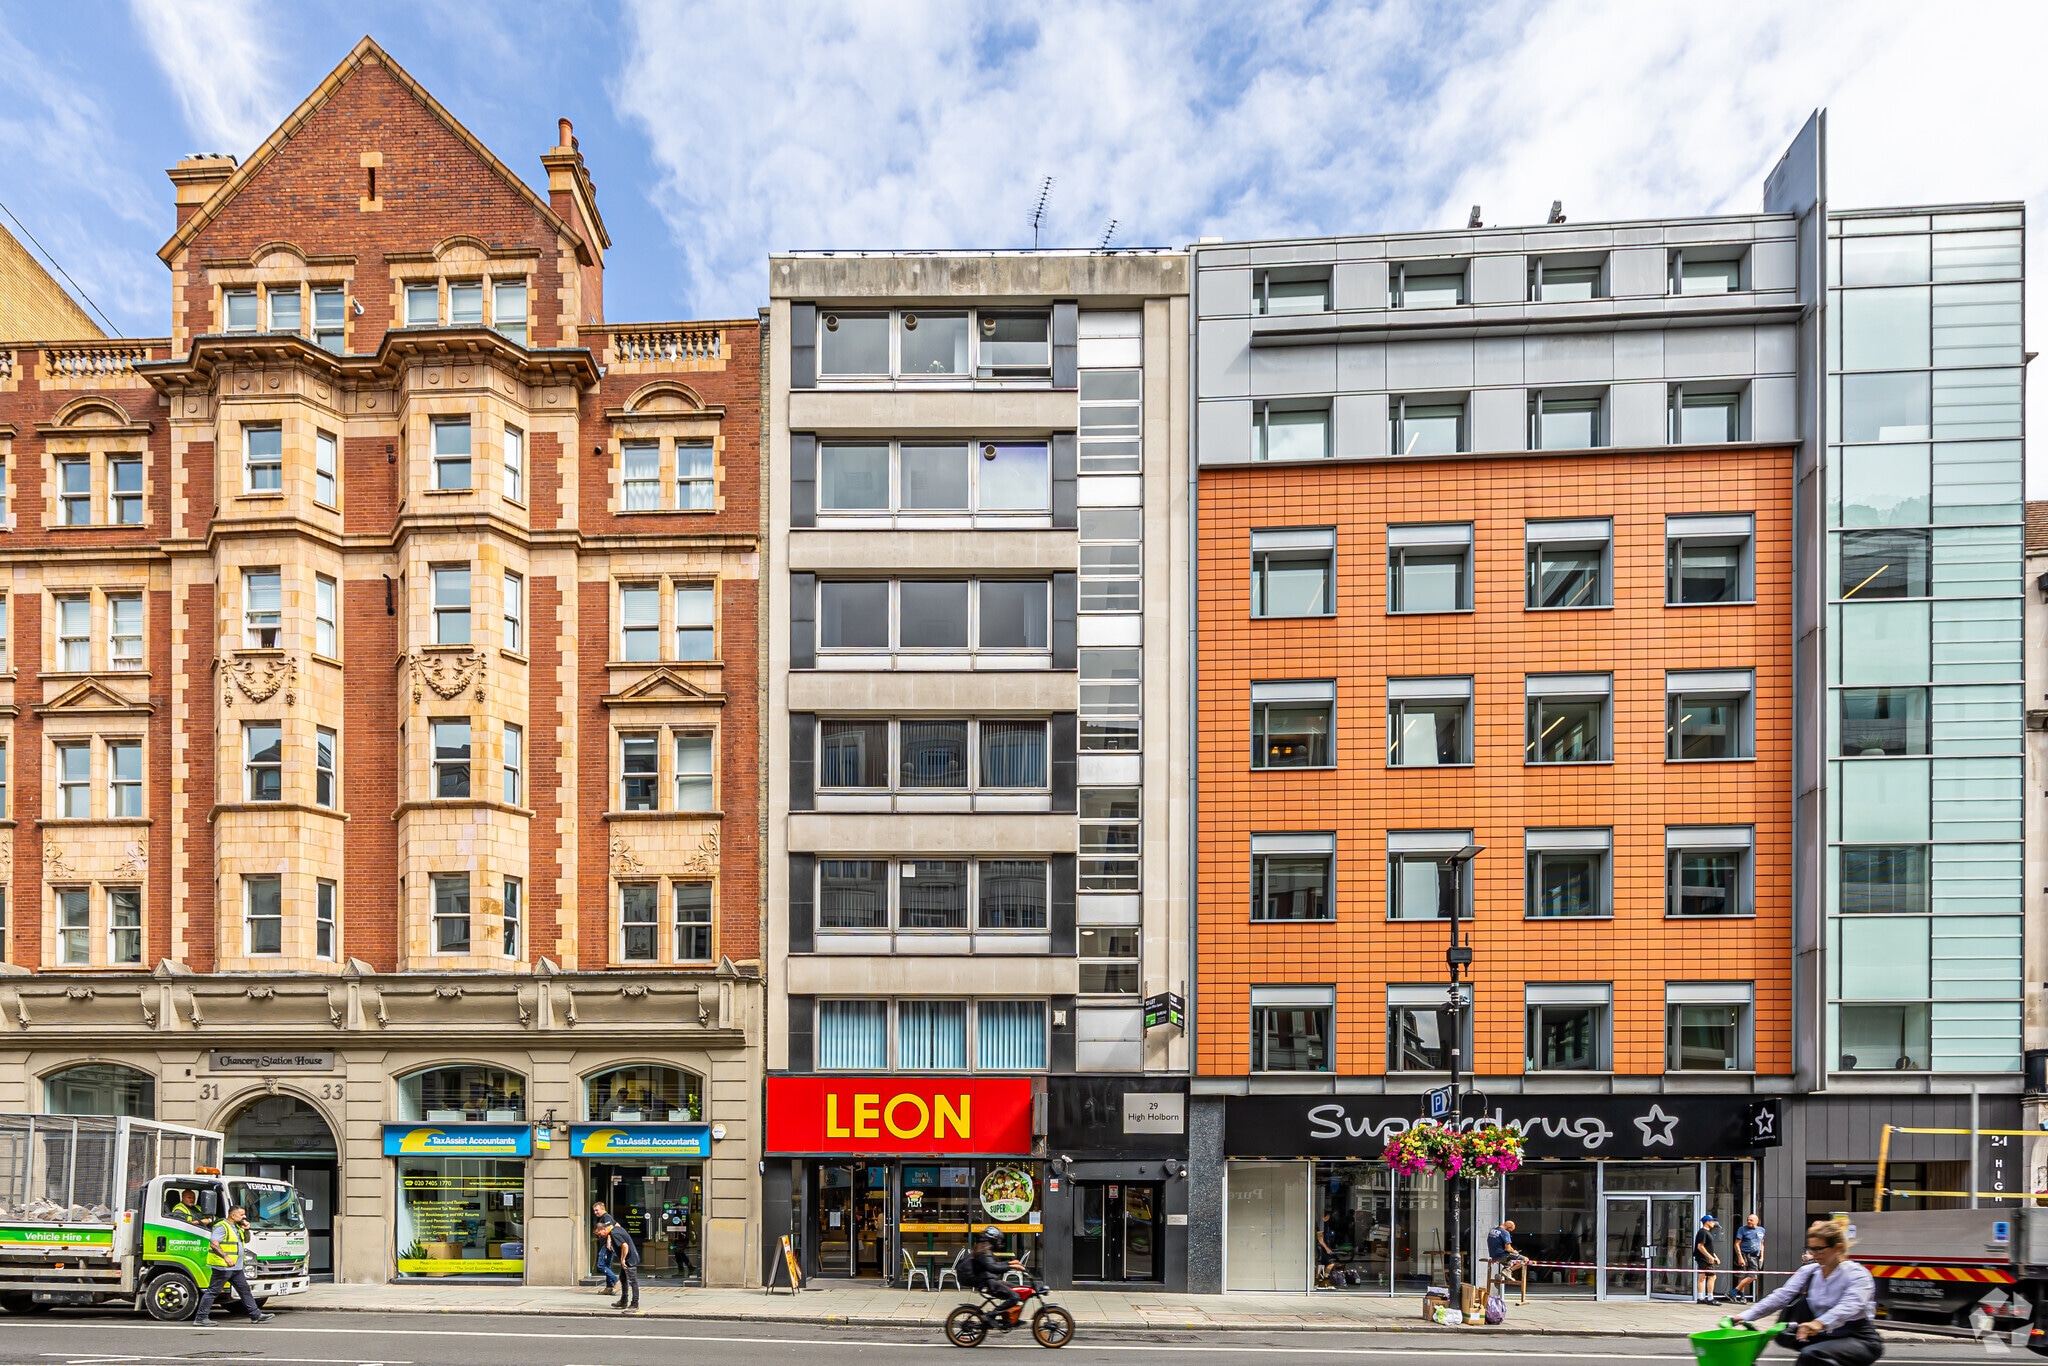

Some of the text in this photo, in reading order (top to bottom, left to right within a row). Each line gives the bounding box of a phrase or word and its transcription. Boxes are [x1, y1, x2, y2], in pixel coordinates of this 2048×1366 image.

[220, 1055, 322, 1068] Chancery Station House
[200, 1084, 220, 1100] 31
[320, 1084, 344, 1100] 33
[1435, 1096, 1441, 1111] P
[826, 1092, 970, 1140] LEON
[1128, 1113, 1145, 1122] High
[432, 1136, 516, 1145] TaxAssist Accountants
[615, 1137, 699, 1146] TaxAssist Accountants
[1991, 1135, 2008, 1146] 24
[246, 1182, 272, 1191] VEHICLE
[25, 1232, 60, 1240] Vehicle
